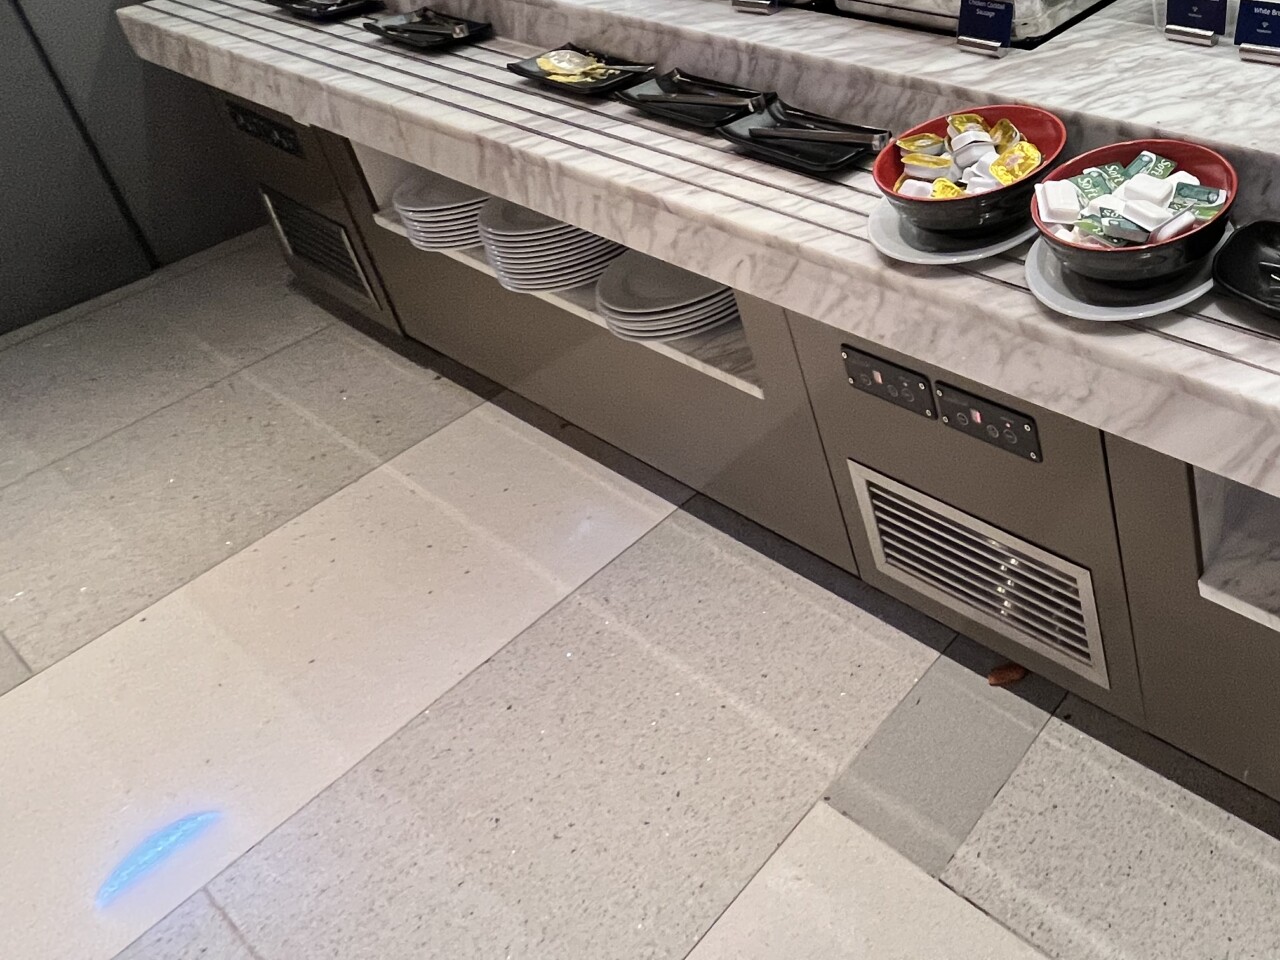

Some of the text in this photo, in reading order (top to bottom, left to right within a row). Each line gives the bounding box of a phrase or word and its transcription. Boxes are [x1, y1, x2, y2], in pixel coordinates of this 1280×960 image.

[1254, 7, 1271, 16] White
[1105, 164, 1125, 183] Soft
[1150, 158, 1171, 177] Soft
[1078, 177, 1098, 198] Soft
